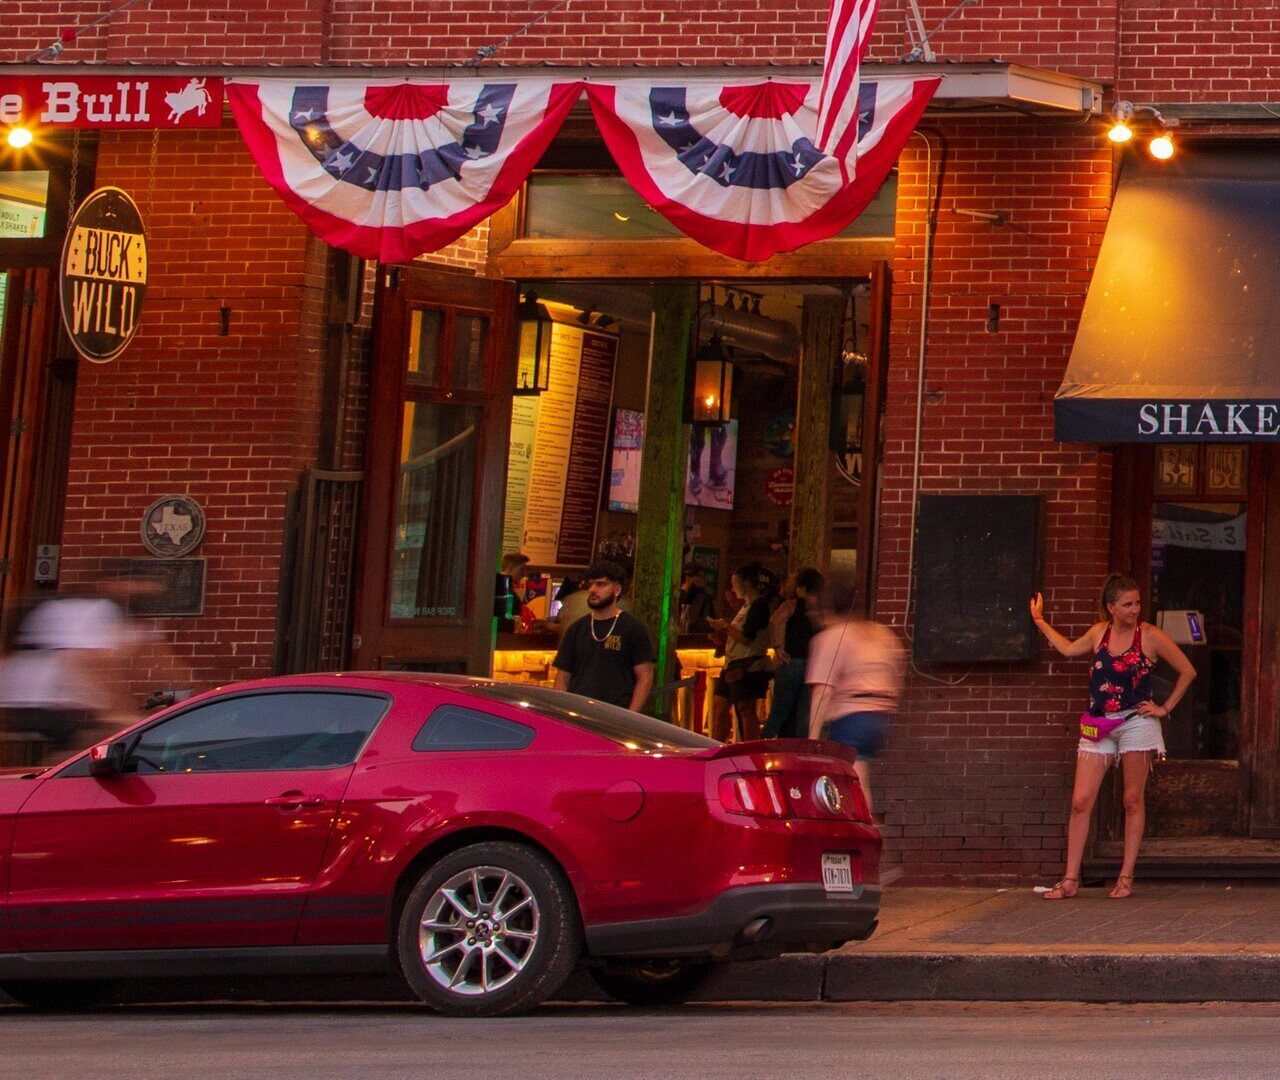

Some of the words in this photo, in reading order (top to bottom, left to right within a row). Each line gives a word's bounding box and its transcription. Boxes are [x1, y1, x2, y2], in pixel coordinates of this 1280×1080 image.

[40, 81, 151, 124] Bull
[84, 229, 133, 281] BUCK
[72, 279, 137, 339] WILD
